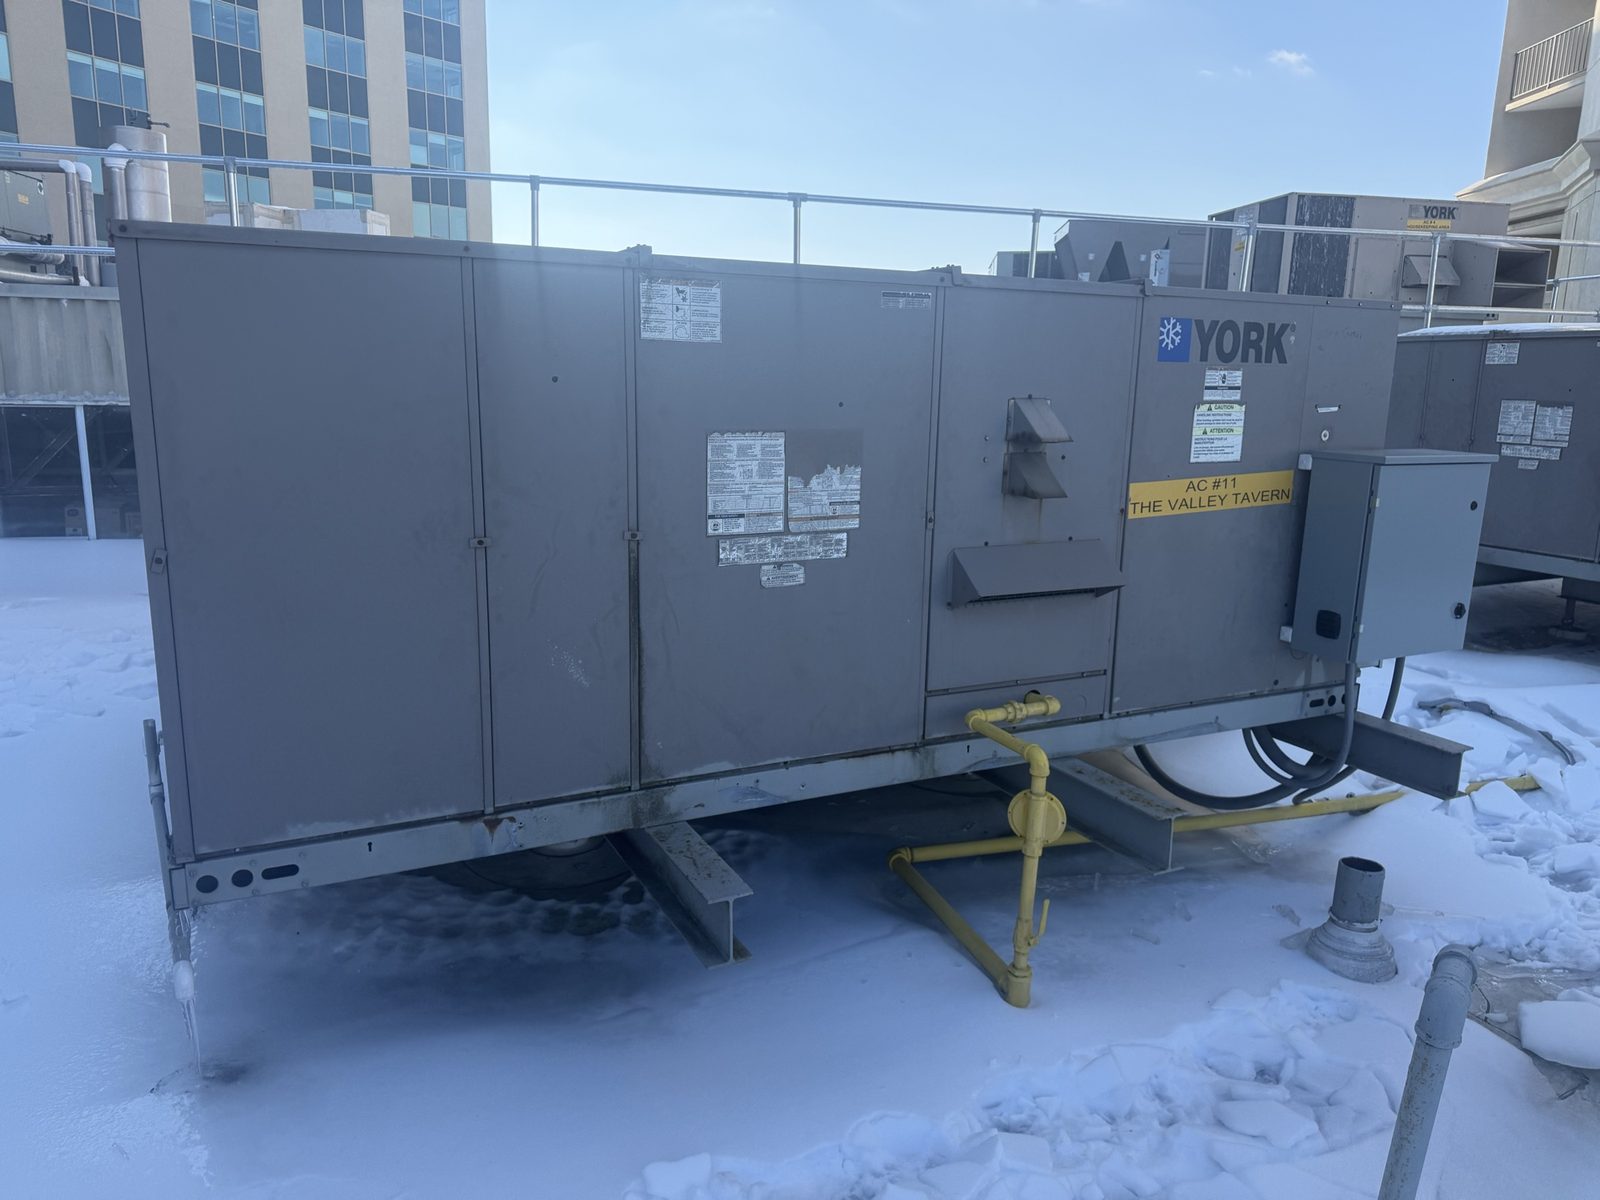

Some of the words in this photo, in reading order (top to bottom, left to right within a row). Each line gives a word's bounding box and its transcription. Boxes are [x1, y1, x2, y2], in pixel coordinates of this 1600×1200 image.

[1423, 205, 1456, 219] YORK
[1194, 319, 1291, 364] YORK
[1185, 479, 1208, 493] AC
[1212, 477, 1237, 490] #11
[1130, 500, 1163, 514] THE
[1168, 494, 1228, 511] VALLEY
[1232, 488, 1291, 505] TAVERN
